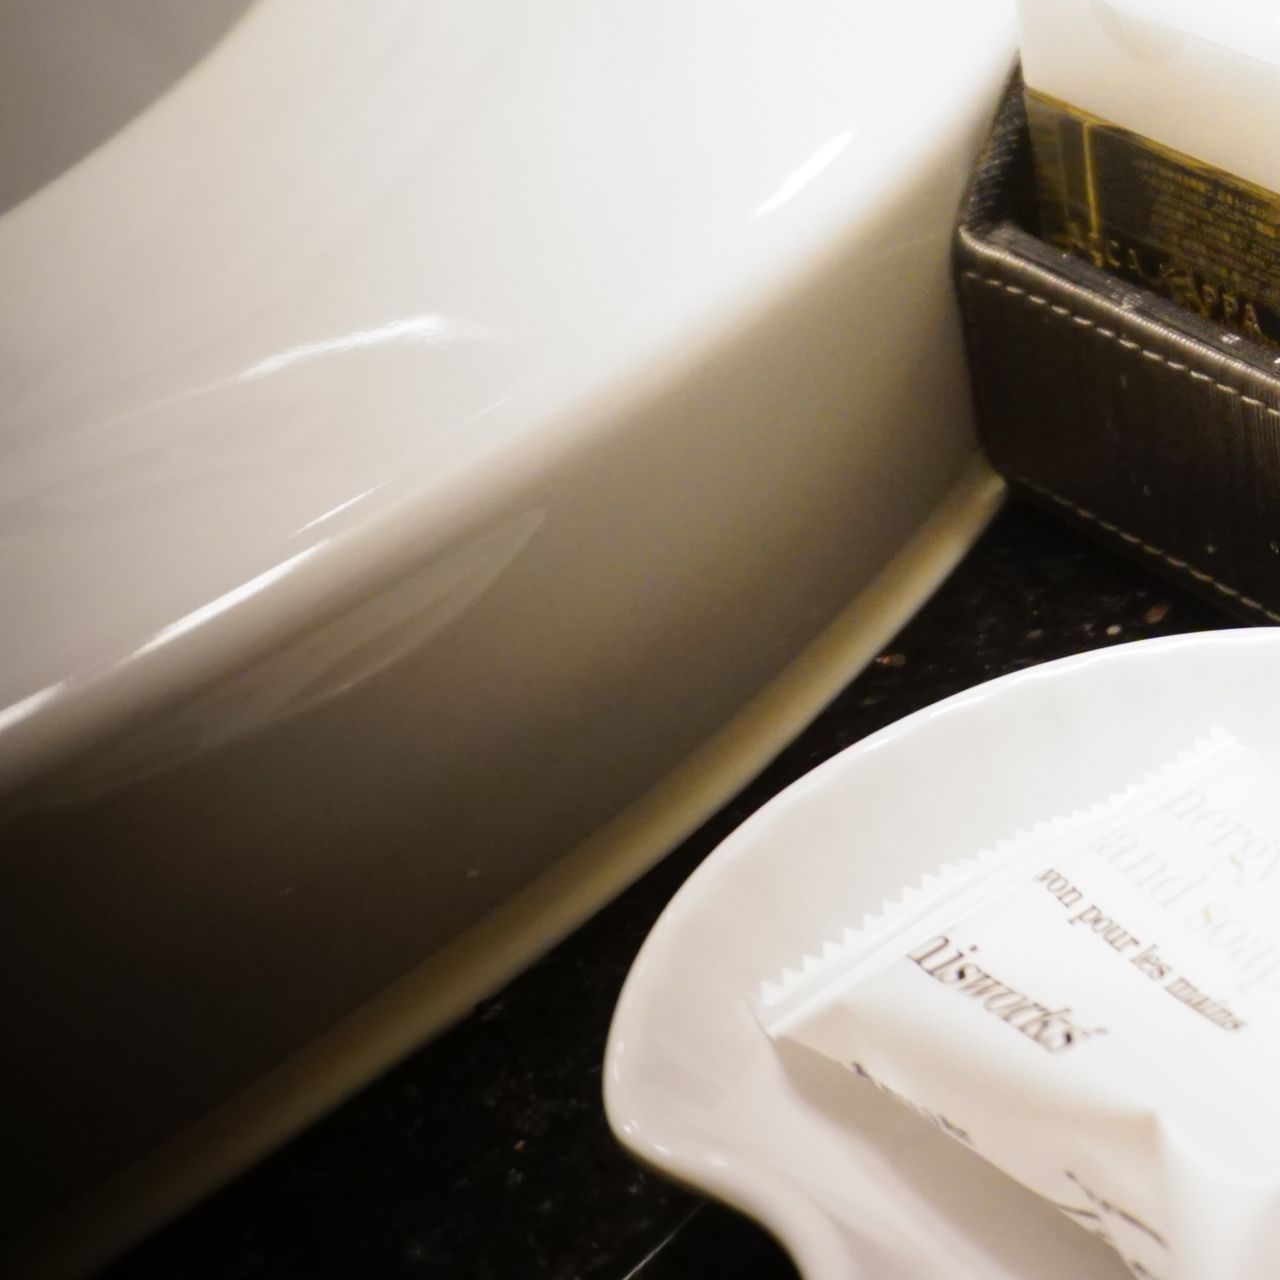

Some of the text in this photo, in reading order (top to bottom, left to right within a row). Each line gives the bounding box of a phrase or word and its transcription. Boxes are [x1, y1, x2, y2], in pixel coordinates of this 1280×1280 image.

[1067, 903, 1141, 954] pour
[1129, 943, 1174, 982] les
[1162, 976, 1249, 1033] mains
